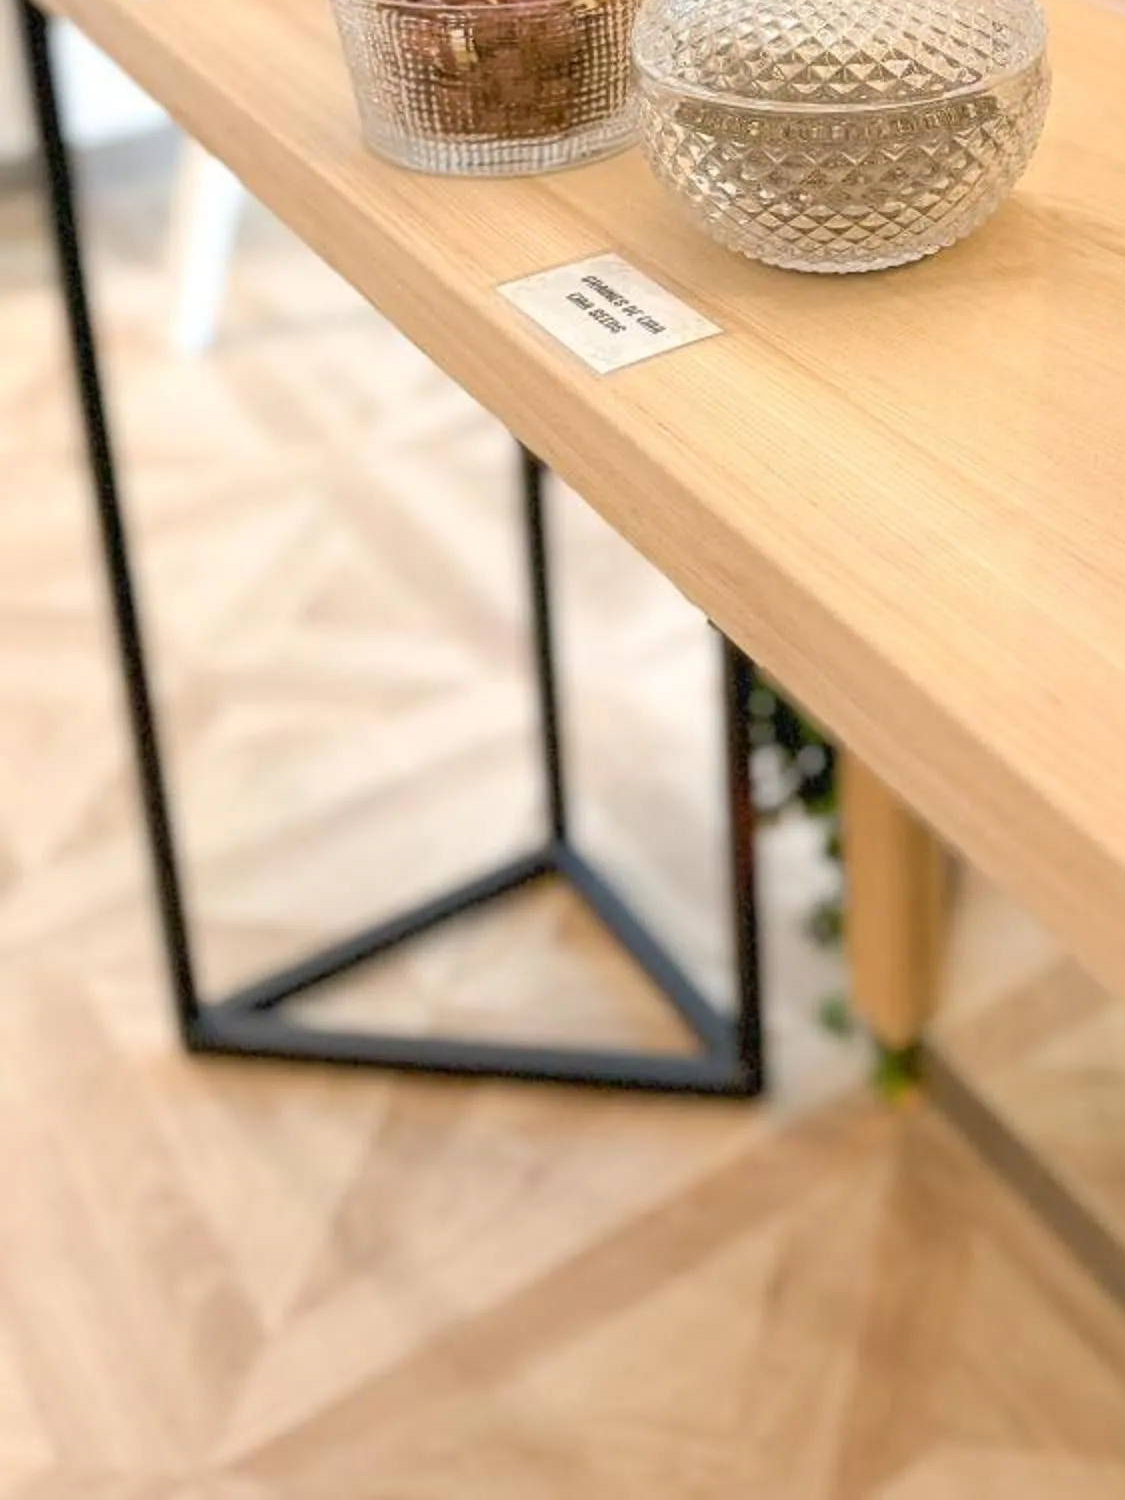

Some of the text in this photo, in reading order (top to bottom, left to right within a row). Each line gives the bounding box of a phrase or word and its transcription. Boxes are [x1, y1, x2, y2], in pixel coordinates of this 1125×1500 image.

[581, 276, 629, 306] GRAINES
[622, 305, 644, 316] DE
[588, 308, 626, 332] SEEDS
